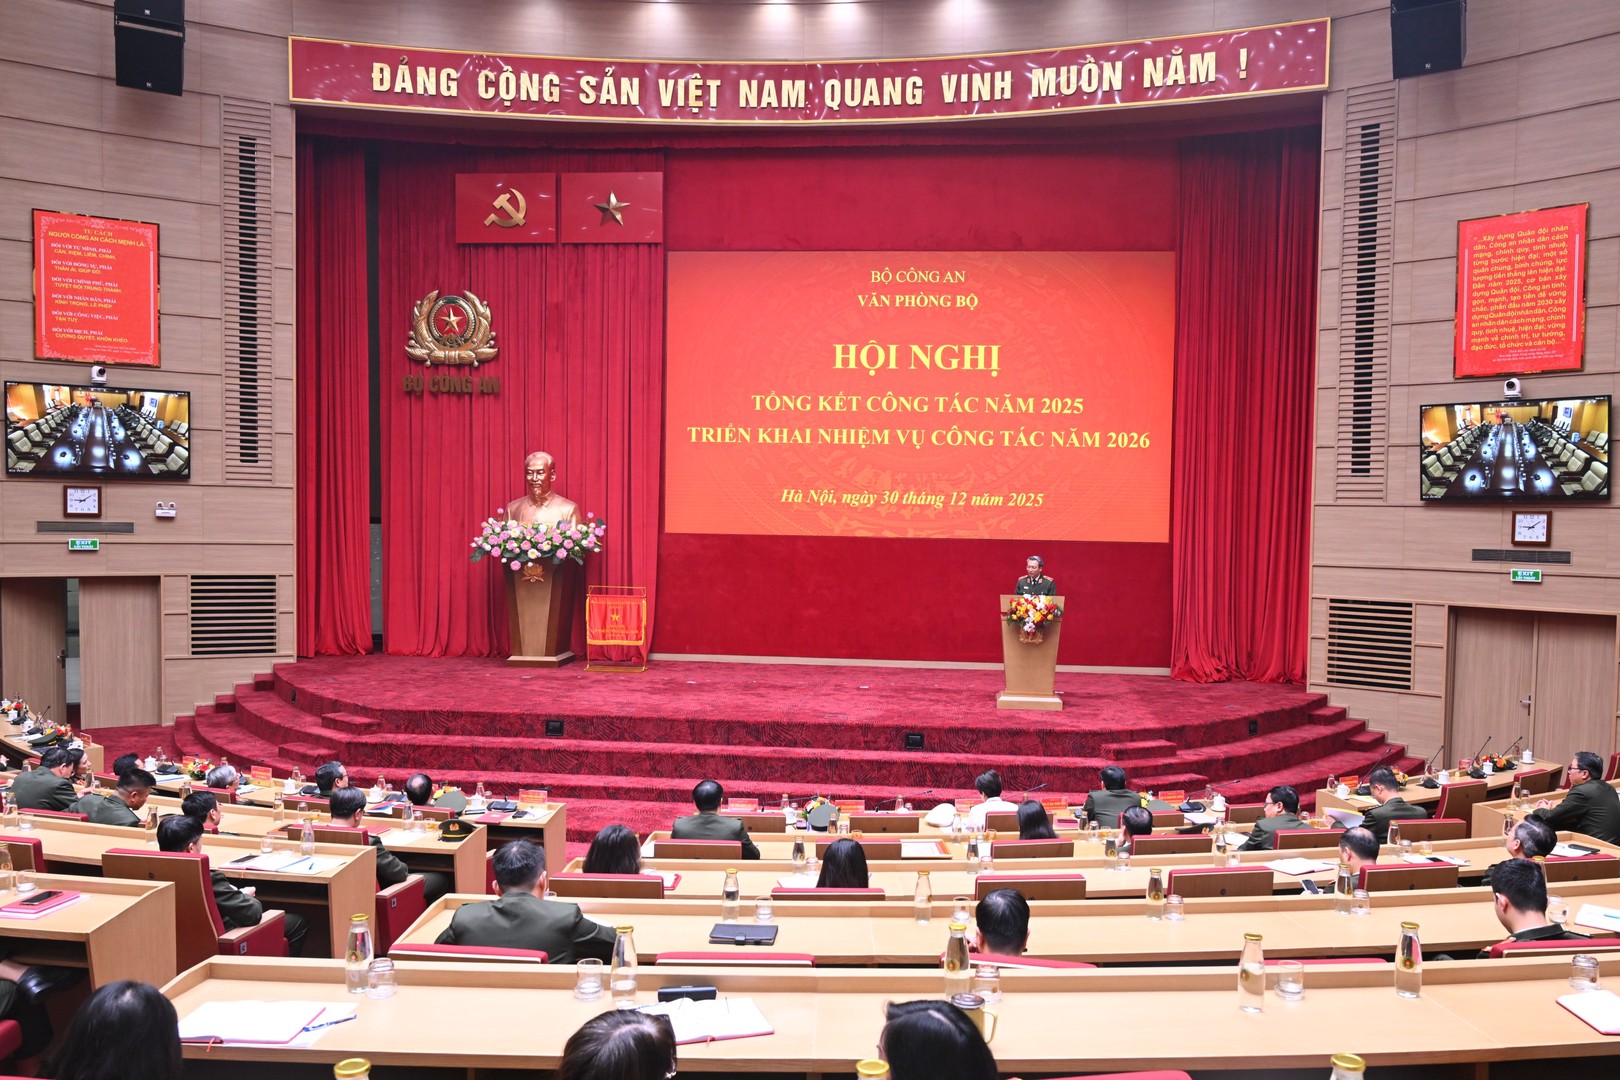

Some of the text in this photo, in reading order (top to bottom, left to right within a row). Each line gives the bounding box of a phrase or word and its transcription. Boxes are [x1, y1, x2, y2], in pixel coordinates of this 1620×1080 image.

[371, 48, 1249, 113] ĐẢNG CỘNG SẢN VIỆT NAM QUANG VINH MUÔN NĂM !
[870, 267, 966, 284] BỘ CÔNG AN
[857, 292, 979, 310] VĂN PHÒNG BỘ
[832, 340, 1001, 377] HỘI NGHỊ
[403, 371, 499, 395] BỘ CÔNG AN
[751, 391, 1084, 413] TỔNG KẾT CÔNG TÁC NĂM 2025
[687, 424, 1151, 449] TRIỂN KHAI NHIỆM VỤ CÔNG TÁC NĂM 2026
[780, 489, 1044, 508] Hà Nội, ngày 30 tháng 12 năm 2025
